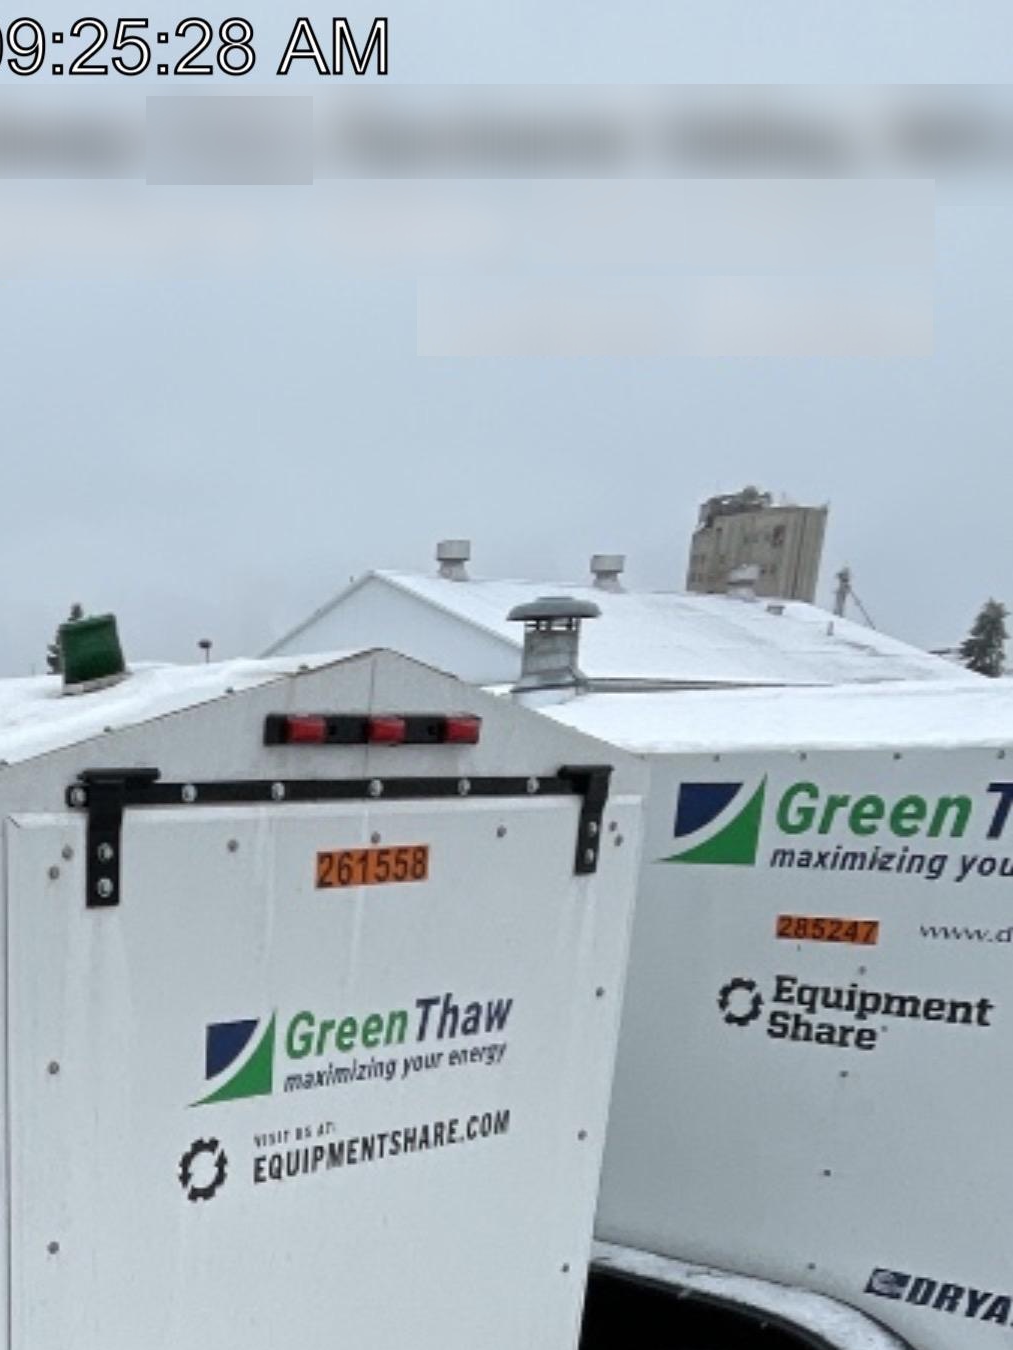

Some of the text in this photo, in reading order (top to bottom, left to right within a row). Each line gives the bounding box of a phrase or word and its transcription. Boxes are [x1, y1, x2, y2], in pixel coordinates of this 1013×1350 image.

[317, 845, 428, 888] 261558
[770, 845, 948, 880] maximizing
[777, 916, 879, 944] 285247
[772, 974, 994, 1026] Equipment
[767, 1010, 877, 1051] Share
[284, 1043, 508, 1093] maximizing your energy
[253, 1130, 290, 1149] VISIT
[253, 1109, 511, 1184] EQUIPMENTSHARE.COM
[905, 1276, 1013, 1327] DRYA
